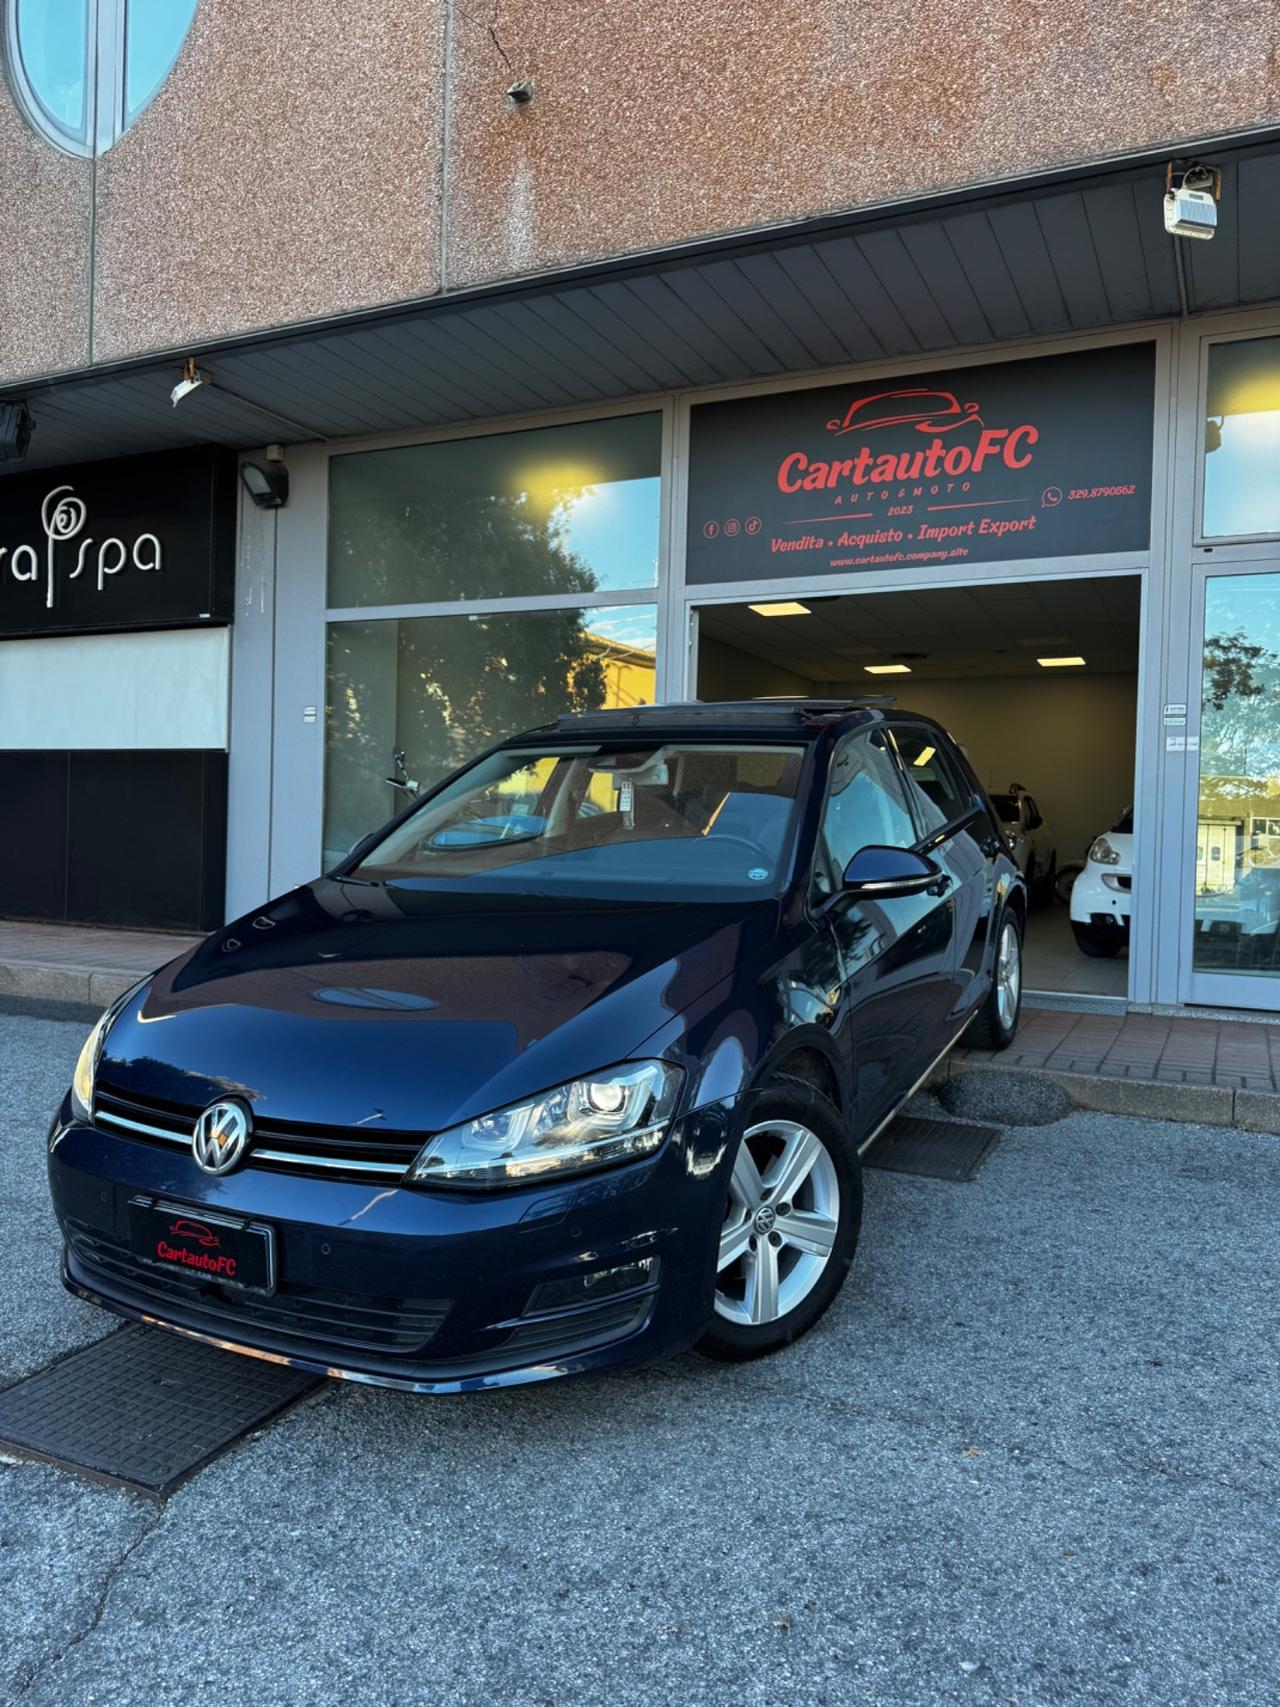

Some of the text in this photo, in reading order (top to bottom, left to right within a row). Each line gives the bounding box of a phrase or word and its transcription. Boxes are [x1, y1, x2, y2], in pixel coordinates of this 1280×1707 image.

[777, 425, 1039, 493] CartautoFC
[1068, 484, 1136, 500] 329.8790562
[887, 505, 914, 517] 2023
[770, 515, 1036, 553] Vendita Acquisto Import Export
[69, 533, 161, 591] spa
[156, 1240, 237, 1277] CartautoFC
